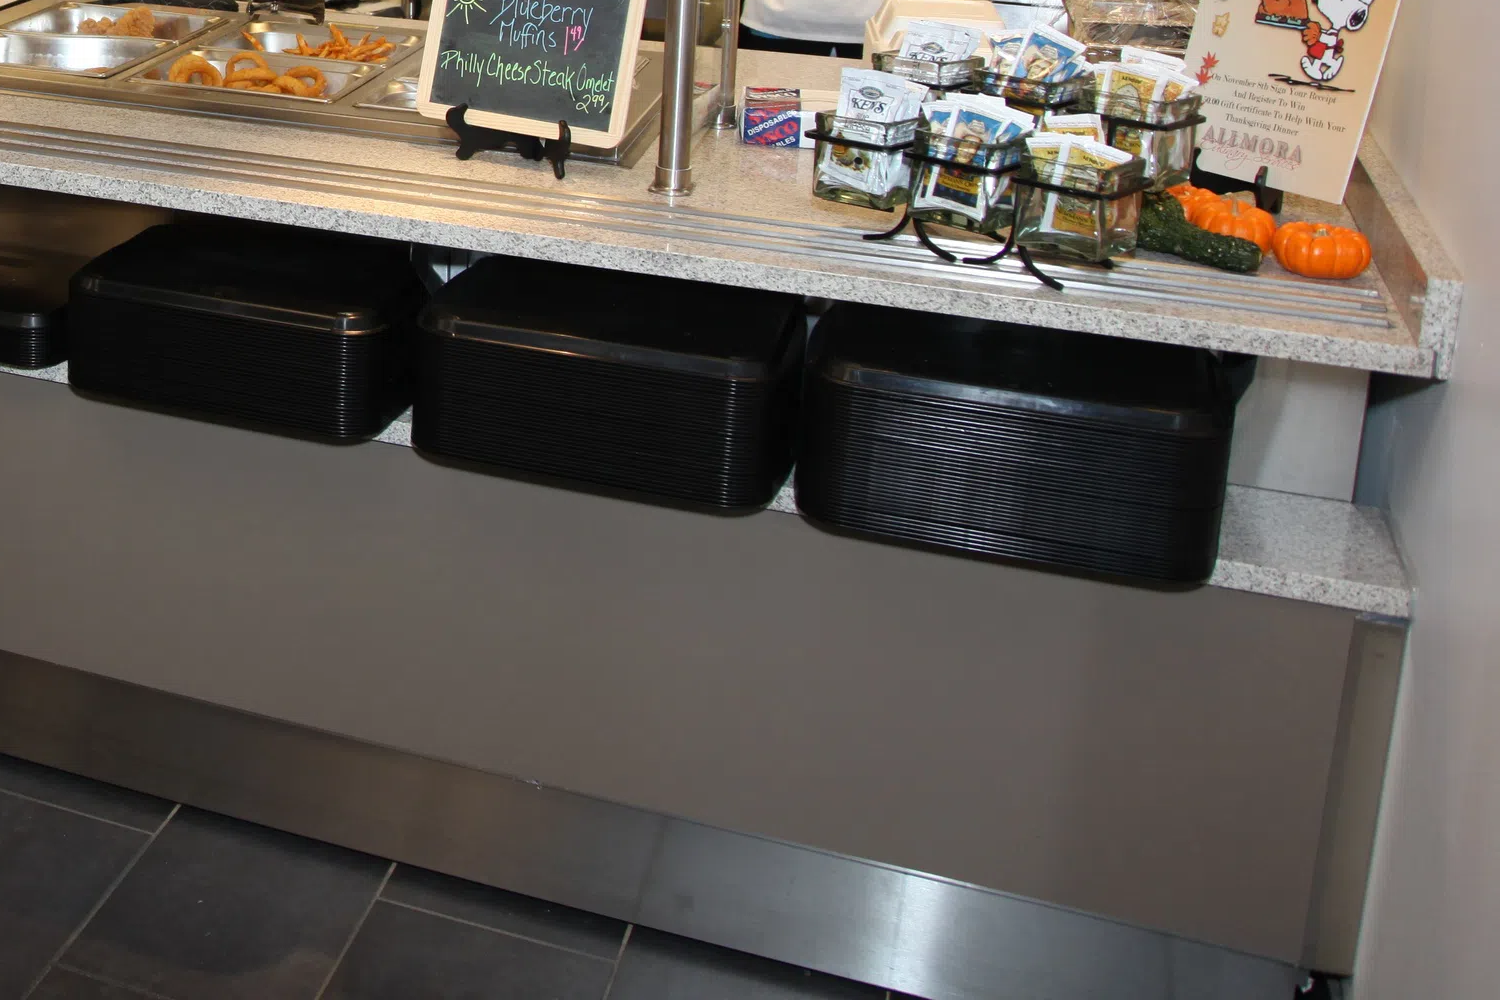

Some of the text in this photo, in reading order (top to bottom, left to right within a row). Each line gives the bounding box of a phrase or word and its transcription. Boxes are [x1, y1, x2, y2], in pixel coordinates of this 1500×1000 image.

[499, 18, 557, 53] Muffins
[441, 49, 485, 87] Philly
[576, 62, 615, 97] Omelet
[1224, 74, 1257, 88] November
[1271, 84, 1288, 95] Sign
[1289, 86, 1308, 99] Your
[1309, 91, 1337, 105] Receipt
[1233, 89, 1306, 111] And Register To Win
[1225, 113, 1300, 137] Thanksgiving Dinner
[1236, 103, 1272, 117] Certificate
[1274, 110, 1283, 119] To
[1284, 112, 1303, 126] Help
[1305, 116, 1324, 129] With
[1327, 121, 1346, 133] Your
